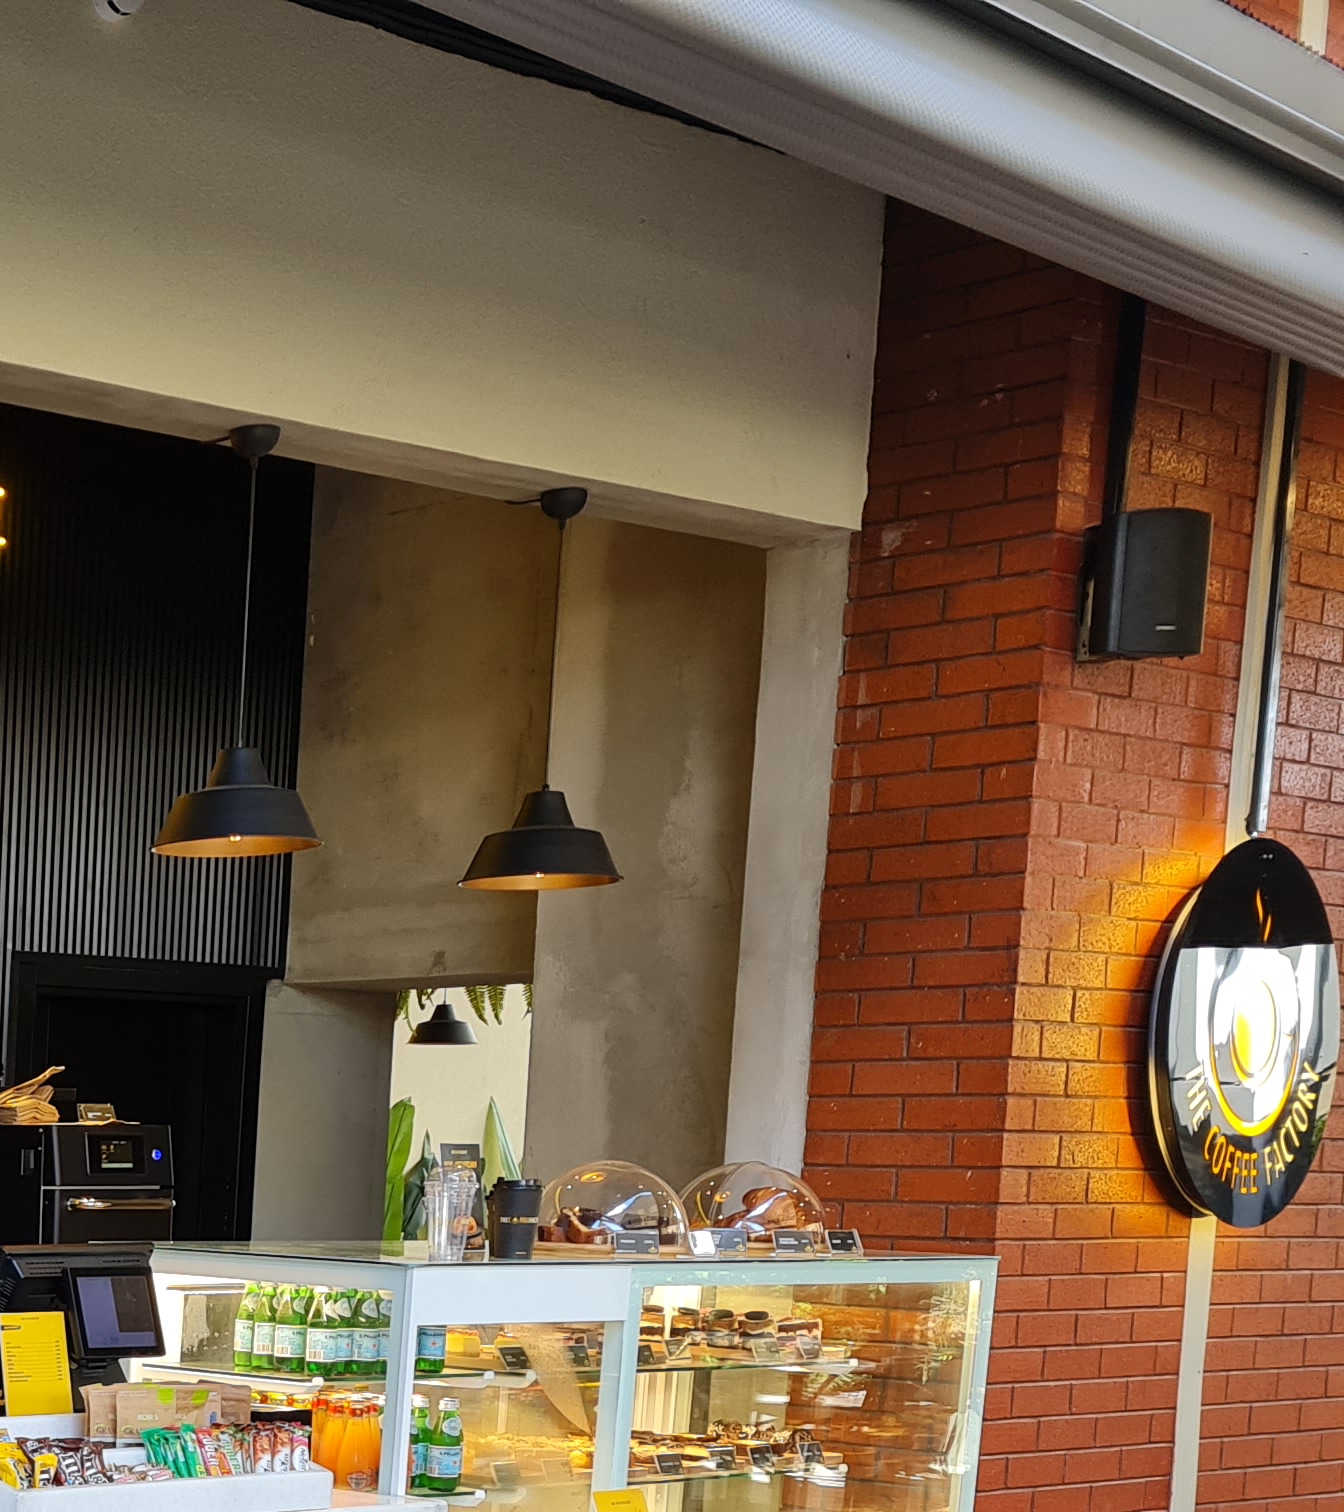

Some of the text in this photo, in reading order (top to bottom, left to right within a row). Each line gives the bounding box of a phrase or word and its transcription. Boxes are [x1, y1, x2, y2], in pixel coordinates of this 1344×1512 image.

[1185, 1061, 1321, 1194] THE COFFEE FACTORY
